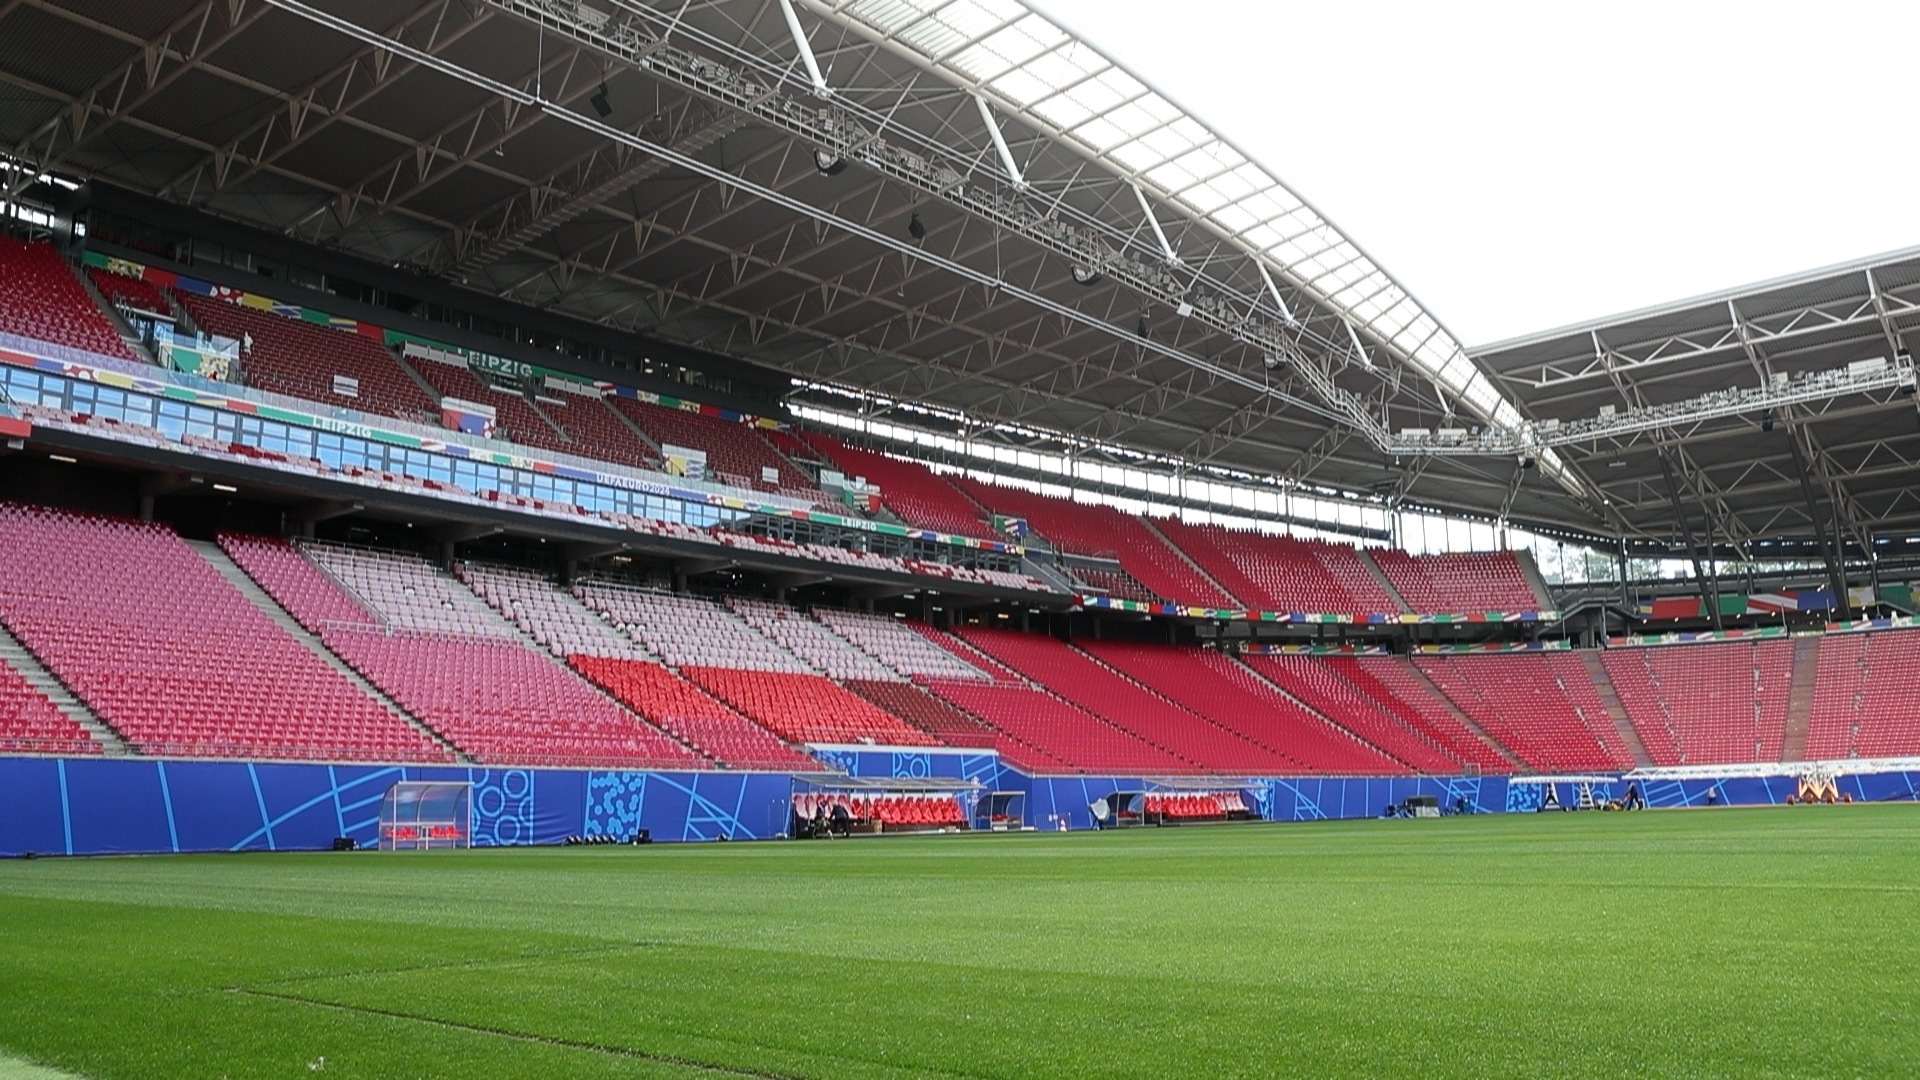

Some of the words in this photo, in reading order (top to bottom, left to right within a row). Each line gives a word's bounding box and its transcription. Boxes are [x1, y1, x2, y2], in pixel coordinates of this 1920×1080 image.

[313, 415, 372, 438] LEIPZIG
[597, 473, 621, 487] UEFA
[841, 517, 877, 531] LEIPZIG
